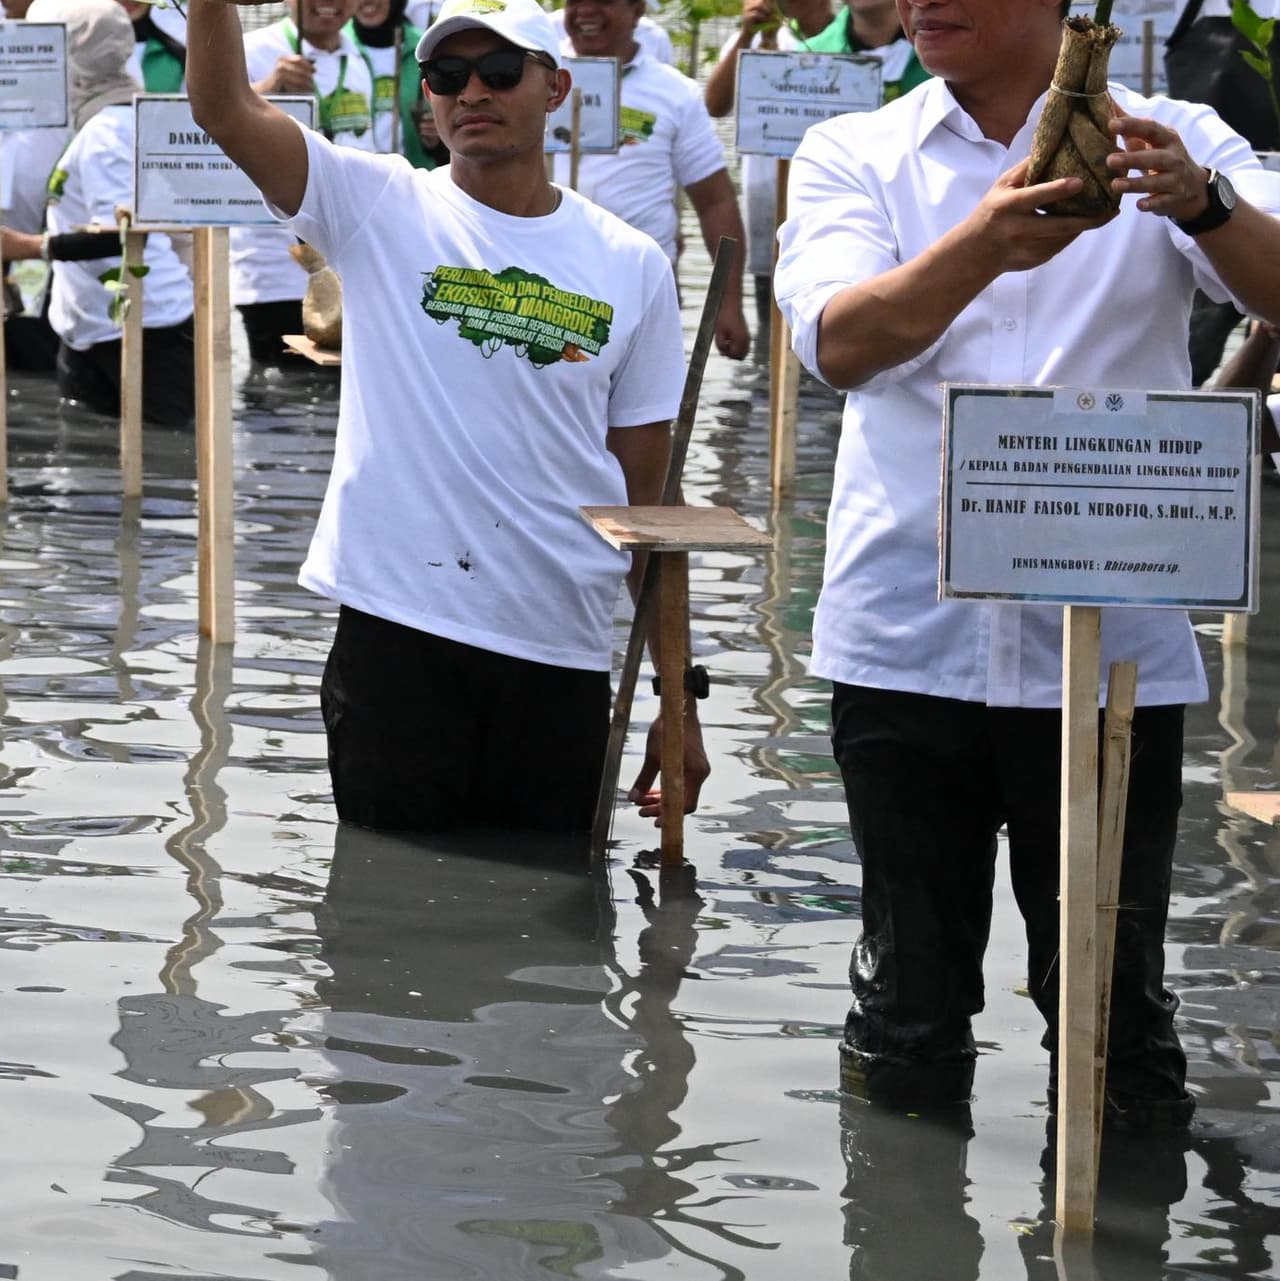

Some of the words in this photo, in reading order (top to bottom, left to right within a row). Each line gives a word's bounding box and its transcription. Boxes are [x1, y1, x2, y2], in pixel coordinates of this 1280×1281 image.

[434, 266, 515, 295] PERLINDUNGAN
[517, 281, 541, 297] DAN
[543, 286, 612, 320] PENGELOLAAN
[435, 284, 516, 311] EKOSISTEM
[518, 297, 597, 337] MANGROVE
[425, 300, 463, 315] BERSAMA
[465, 306, 489, 320] WAKIL
[490, 311, 527, 328] PRESIDEN
[528, 317, 562, 338] REPUBLIK
[563, 326, 600, 354] INDONESIA
[466, 319, 483, 330] DAN
[484, 322, 536, 342] MASYARAKAT
[536, 334, 565, 353] PESISIR
[998, 435, 1058, 451] MENTERI
[1066, 436, 1151, 453] LINGKUNGAN
[1159, 438, 1203, 454] HIDUP
[969, 460, 1009, 472] KEPALA
[1013, 461, 1048, 473] BADAN
[1054, 463, 1131, 476] PENGENDALIAN
[1137, 465, 1201, 478] LINGKUNGAN
[1207, 467, 1240, 479] HIDUP
[961, 498, 981, 513] Dr.
[986, 499, 1026, 514] HANIF
[1034, 501, 1080, 516] FAISOL
[1088, 502, 1153, 520] NUROFIQ,
[1157, 504, 1204, 521] S.Hut.,
[1208, 506, 1236, 521] M.P.
[1012, 557, 1038, 569] JENIS
[1040, 558, 1094, 570] MANGROVE
[1104, 560, 1167, 573] Rhizophora
[1167, 563, 1180, 574] sp.
